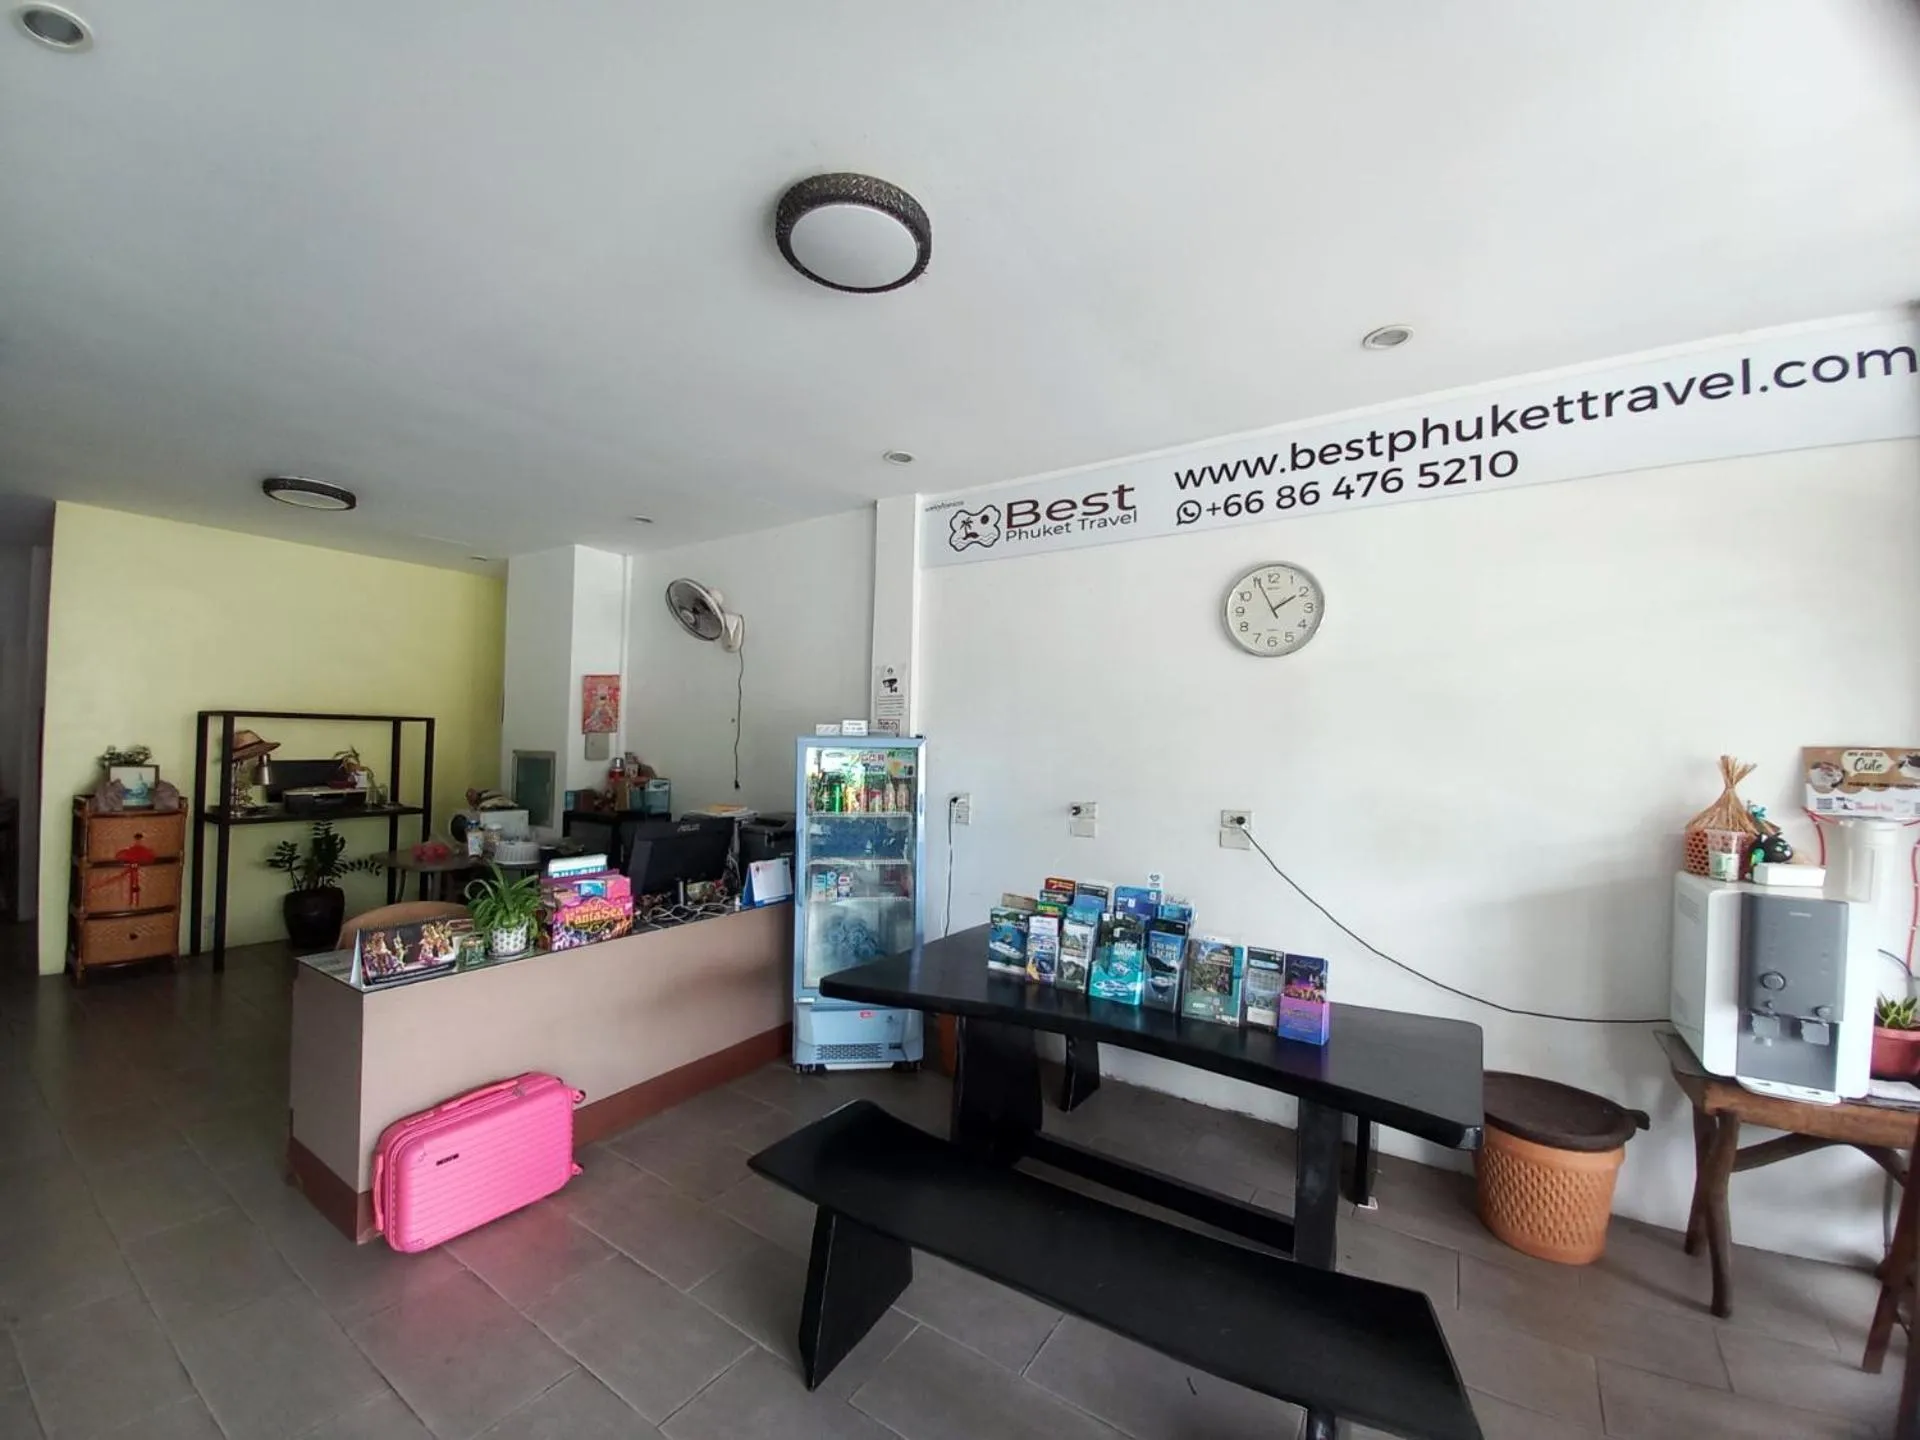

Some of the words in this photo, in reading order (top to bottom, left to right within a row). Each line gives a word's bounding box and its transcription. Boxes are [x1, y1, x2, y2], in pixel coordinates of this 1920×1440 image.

[1174, 345, 1918, 490] www.bestphukettravel.com
[1206, 490, 1264, 517] +66
[1275, 481, 1321, 510] 86
[1332, 467, 1404, 500] 476
[1417, 449, 1519, 488] 5210
[1006, 484, 1136, 529] Best
[1005, 522, 1072, 542] Phuket
[1077, 509, 1137, 531] Travel
[1266, 572, 1281, 584] 12
[1238, 590, 1252, 602] 10
[1299, 586, 1310, 598] 2
[1235, 606, 1245, 617] 9
[1303, 602, 1314, 614] 3
[1239, 621, 1249, 632] 8
[1297, 618, 1307, 629] 4
[1252, 632, 1262, 644] 7
[1266, 636, 1278, 648] 6
[1284, 631, 1295, 643] 5
[1853, 757, 1884, 772] Cute
